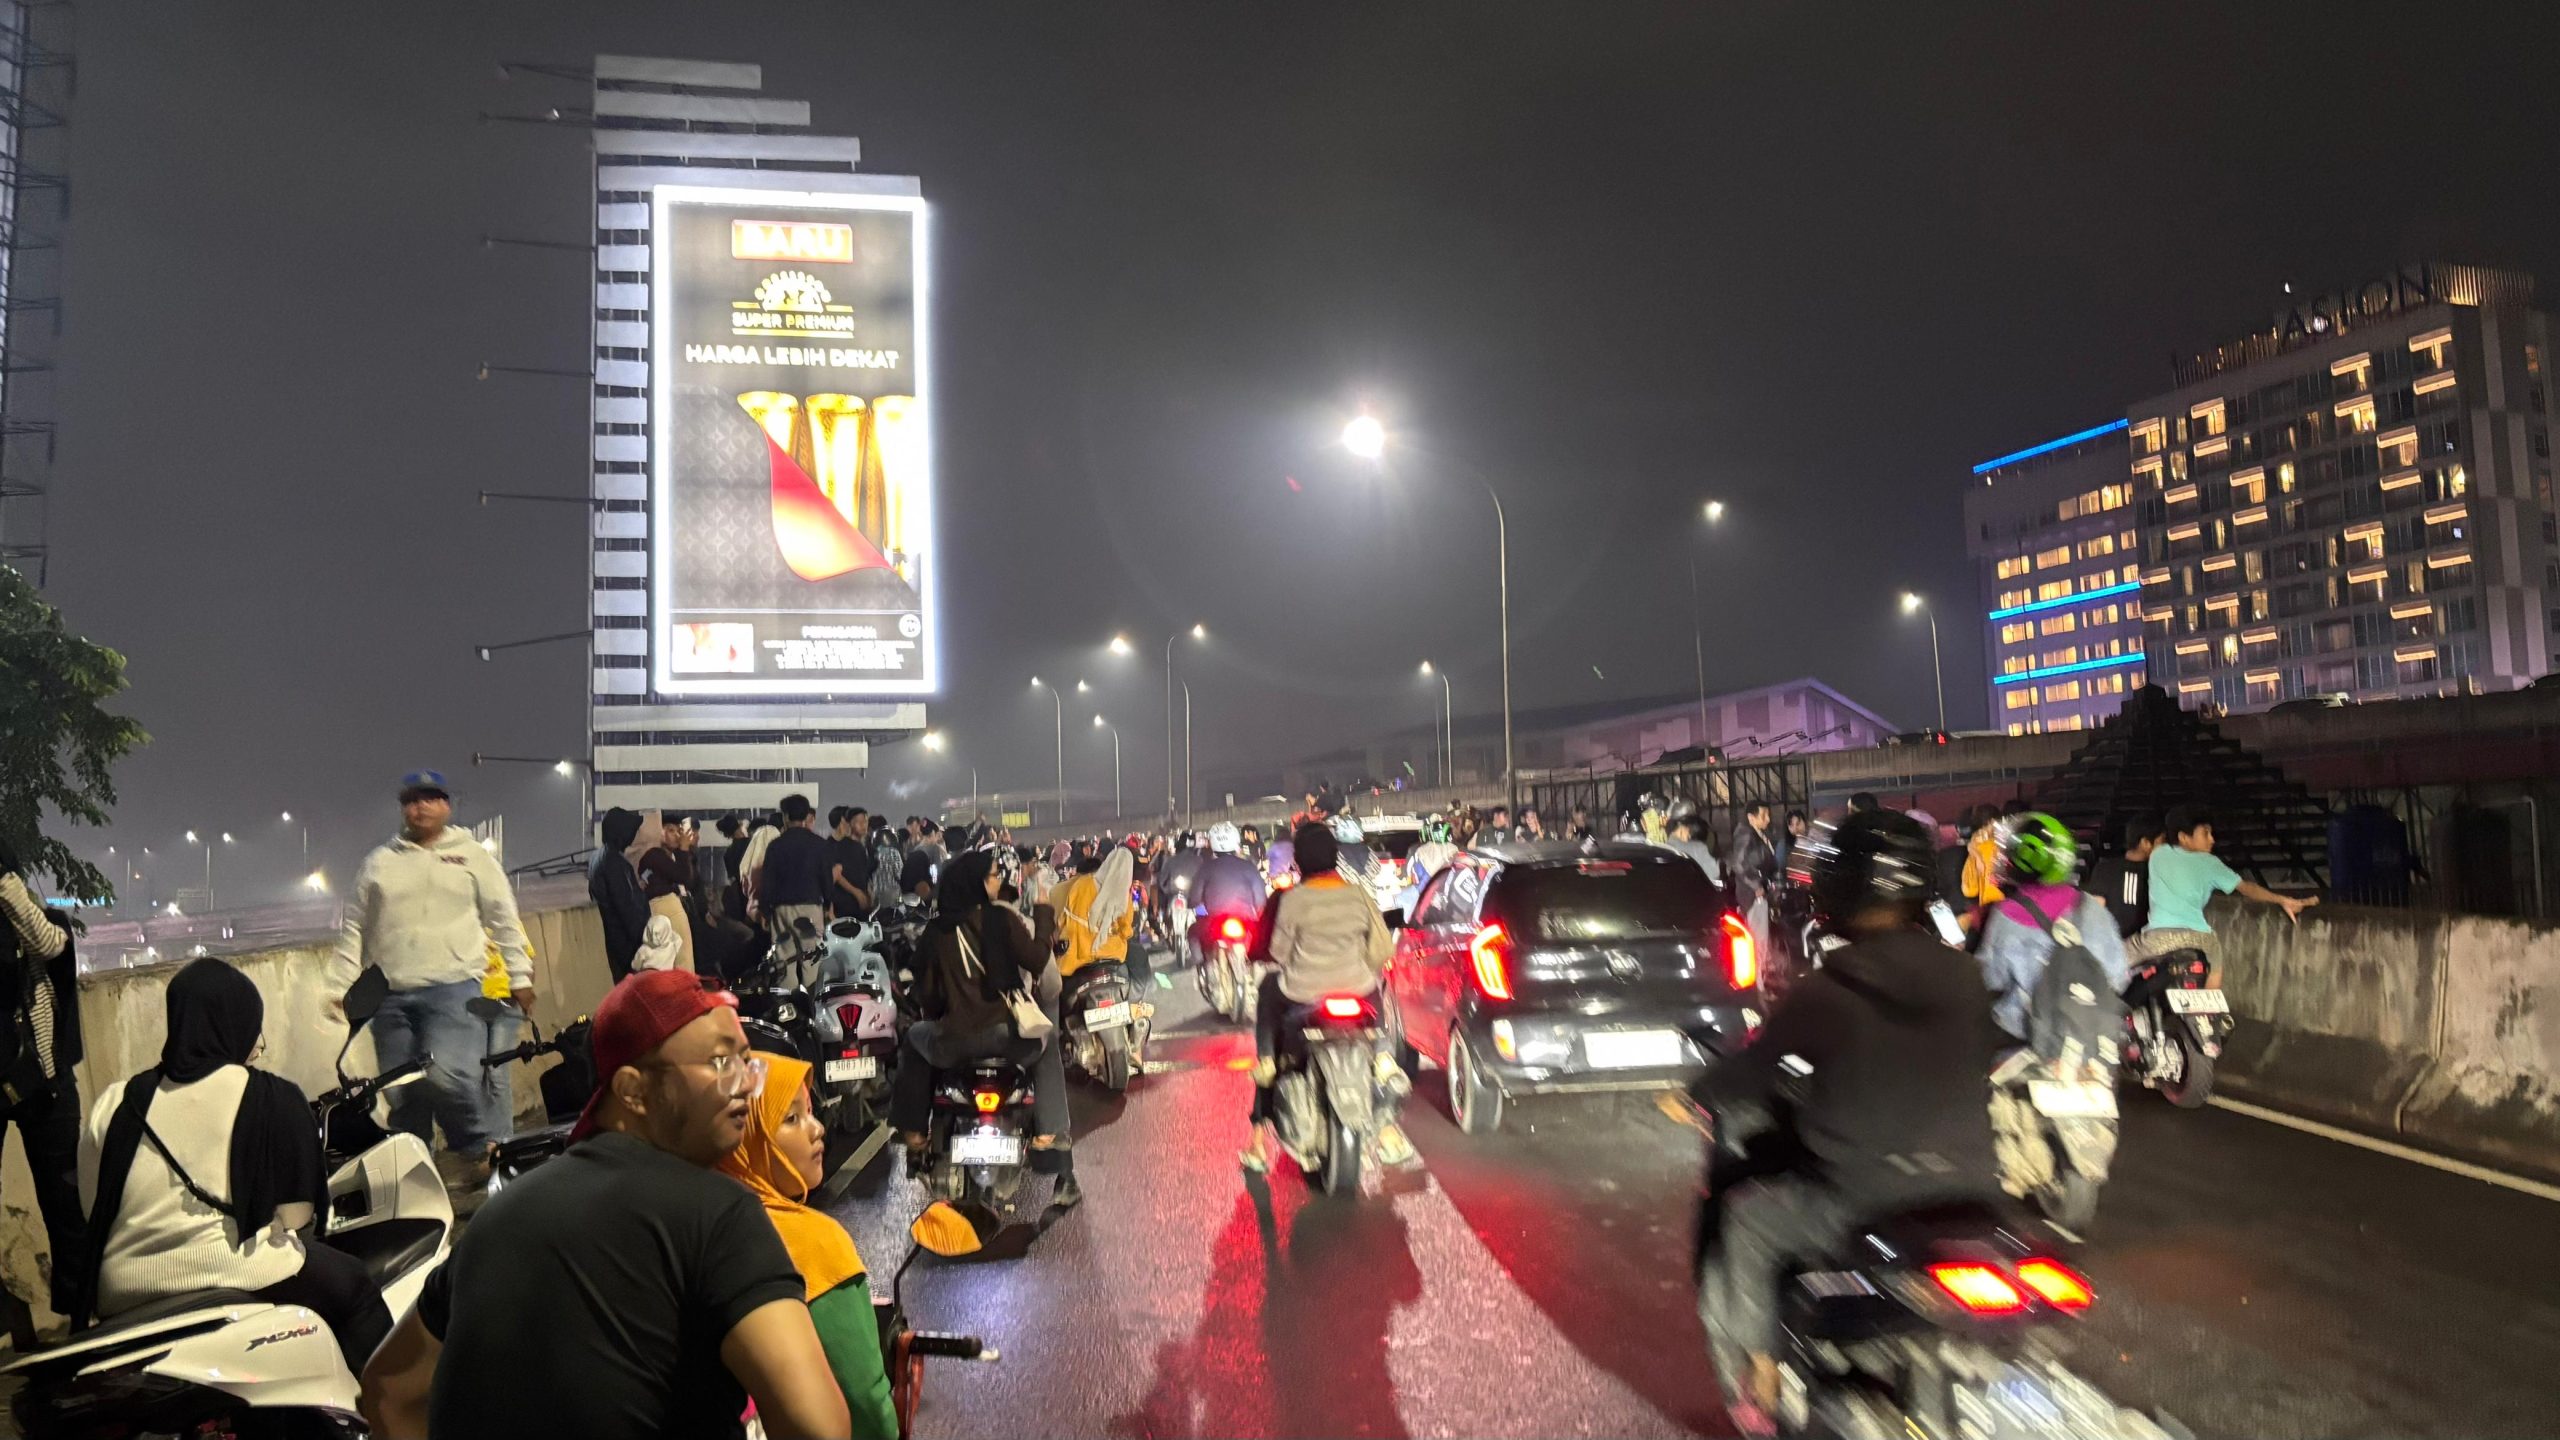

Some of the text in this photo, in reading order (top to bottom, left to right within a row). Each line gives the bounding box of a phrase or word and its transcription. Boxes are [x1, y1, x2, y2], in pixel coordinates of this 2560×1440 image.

[732, 311, 855, 331] SUPER PREMIUM
[685, 343, 899, 370] HARGA LEBIH DEKAT
